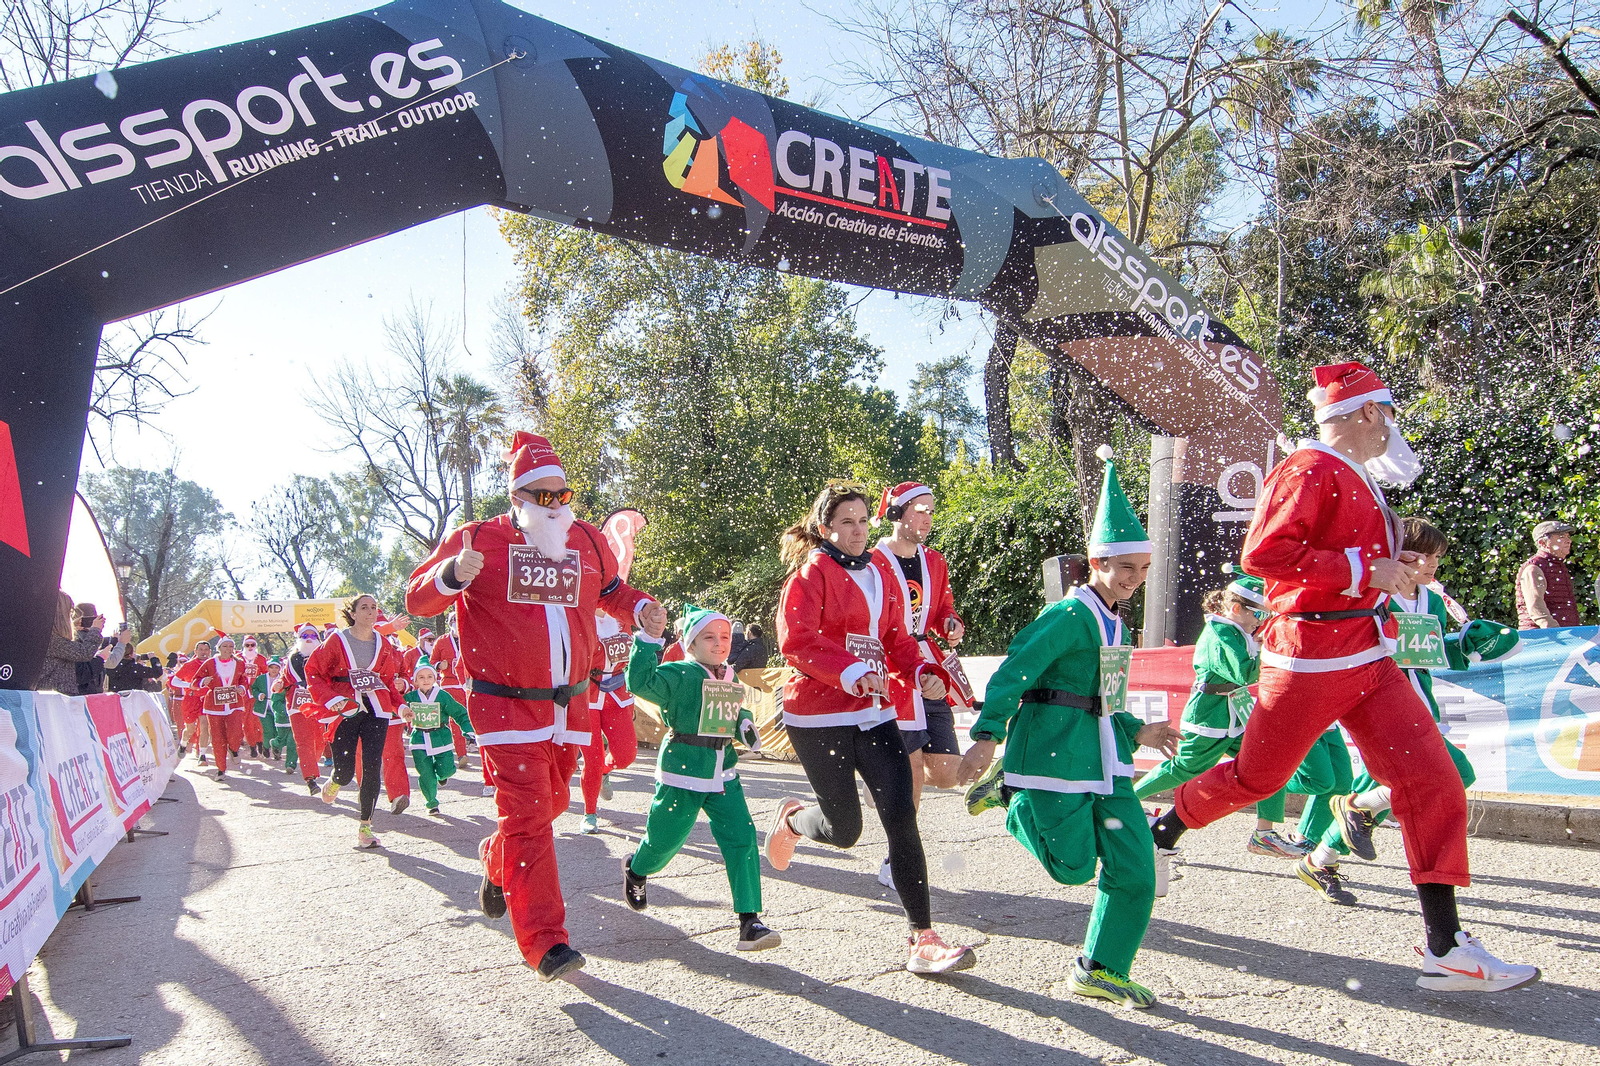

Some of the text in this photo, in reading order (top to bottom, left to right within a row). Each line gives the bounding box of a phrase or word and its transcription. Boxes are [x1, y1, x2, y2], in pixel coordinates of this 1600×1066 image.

[131, 170, 213, 205] TIENDA
[227, 137, 320, 178] RUNNING
[331, 117, 388, 149] TRAIL
[397, 91, 480, 129] OUTDOOR
[776, 130, 952, 221] CREATE
[777, 200, 945, 249] Acción Creativa de Eventos
[1070, 212, 1261, 390] alssport.es
[1100, 273, 1250, 405] TIENDA RUNNING TRAIL OUTDOOR
[519, 565, 558, 588] 328
[256, 604, 283, 614] IMD
[608, 642, 626, 657] 629
[217, 692, 230, 700] 626
[356, 675, 375, 687] 597
[706, 700, 740, 721] 1133
[58, 752, 100, 821] CREATE
[2, 908, 27, 945] Creativa
